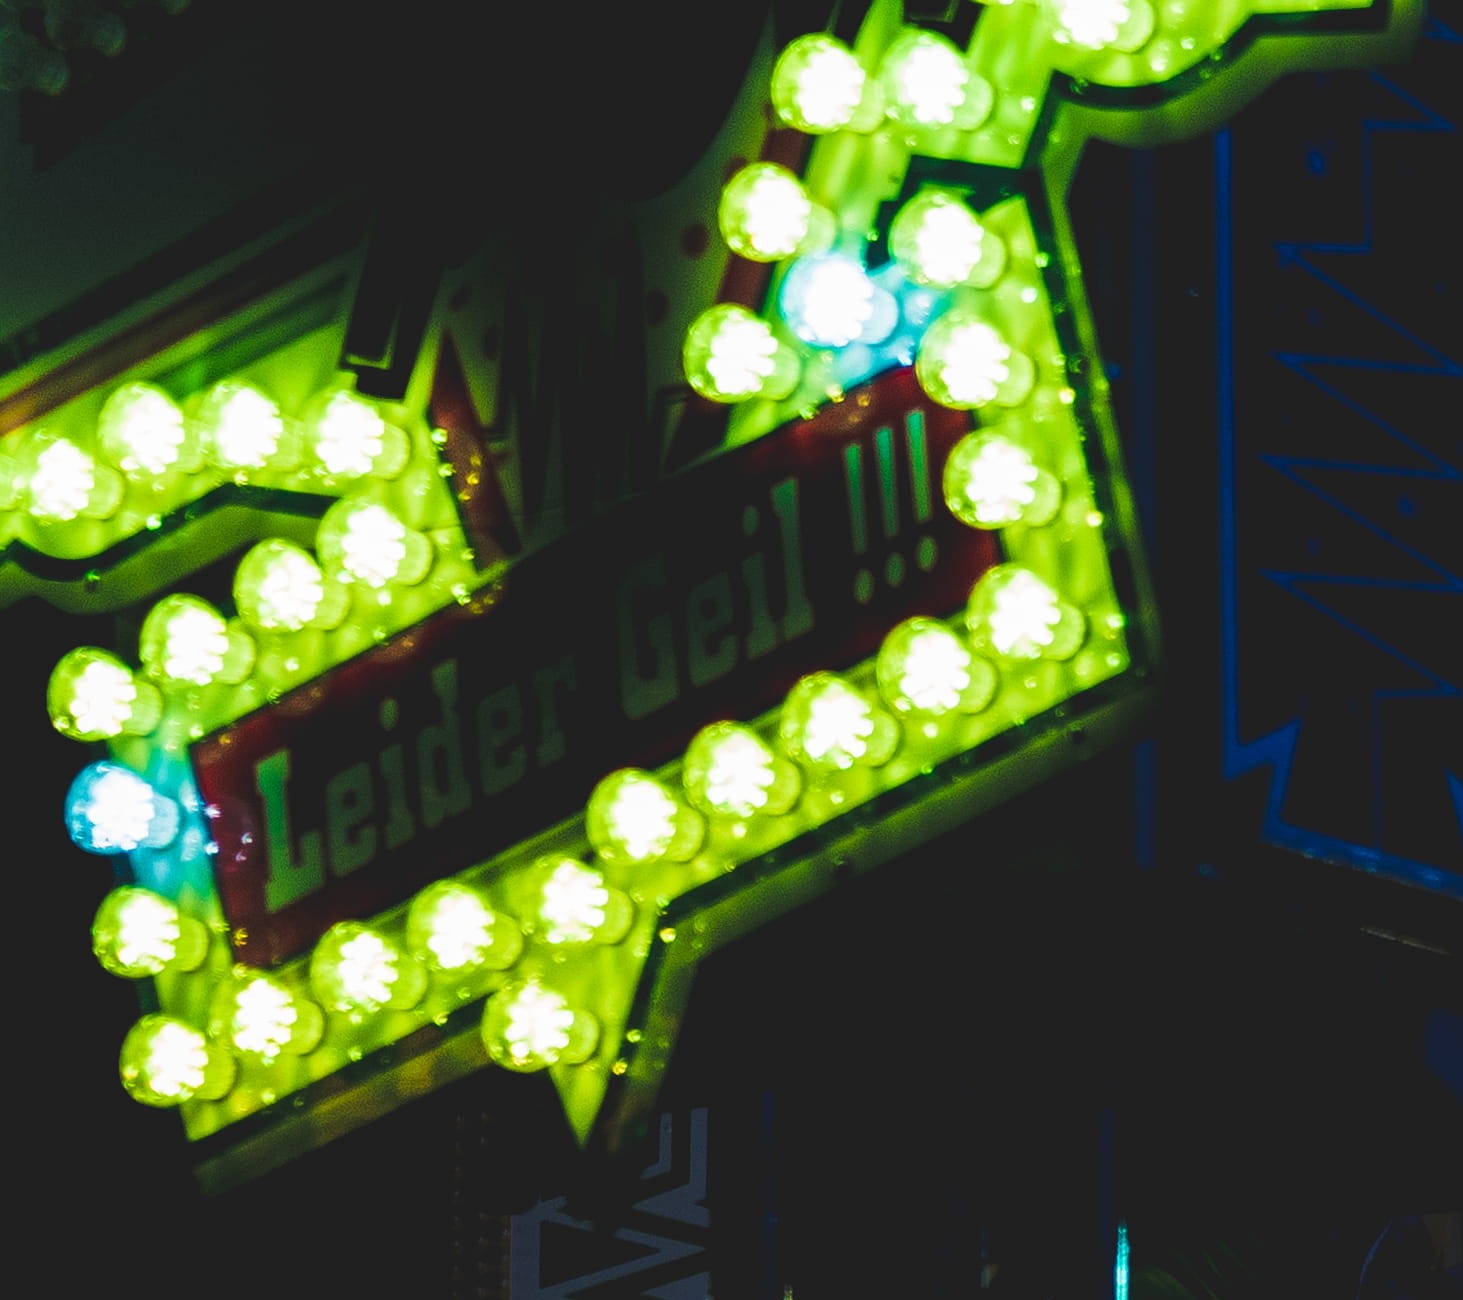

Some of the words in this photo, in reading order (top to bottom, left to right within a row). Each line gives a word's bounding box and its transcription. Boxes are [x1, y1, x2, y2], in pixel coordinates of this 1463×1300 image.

[254, 653, 578, 914] Leider
[616, 476, 815, 720] Geil
[842, 409, 939, 604] !!!
